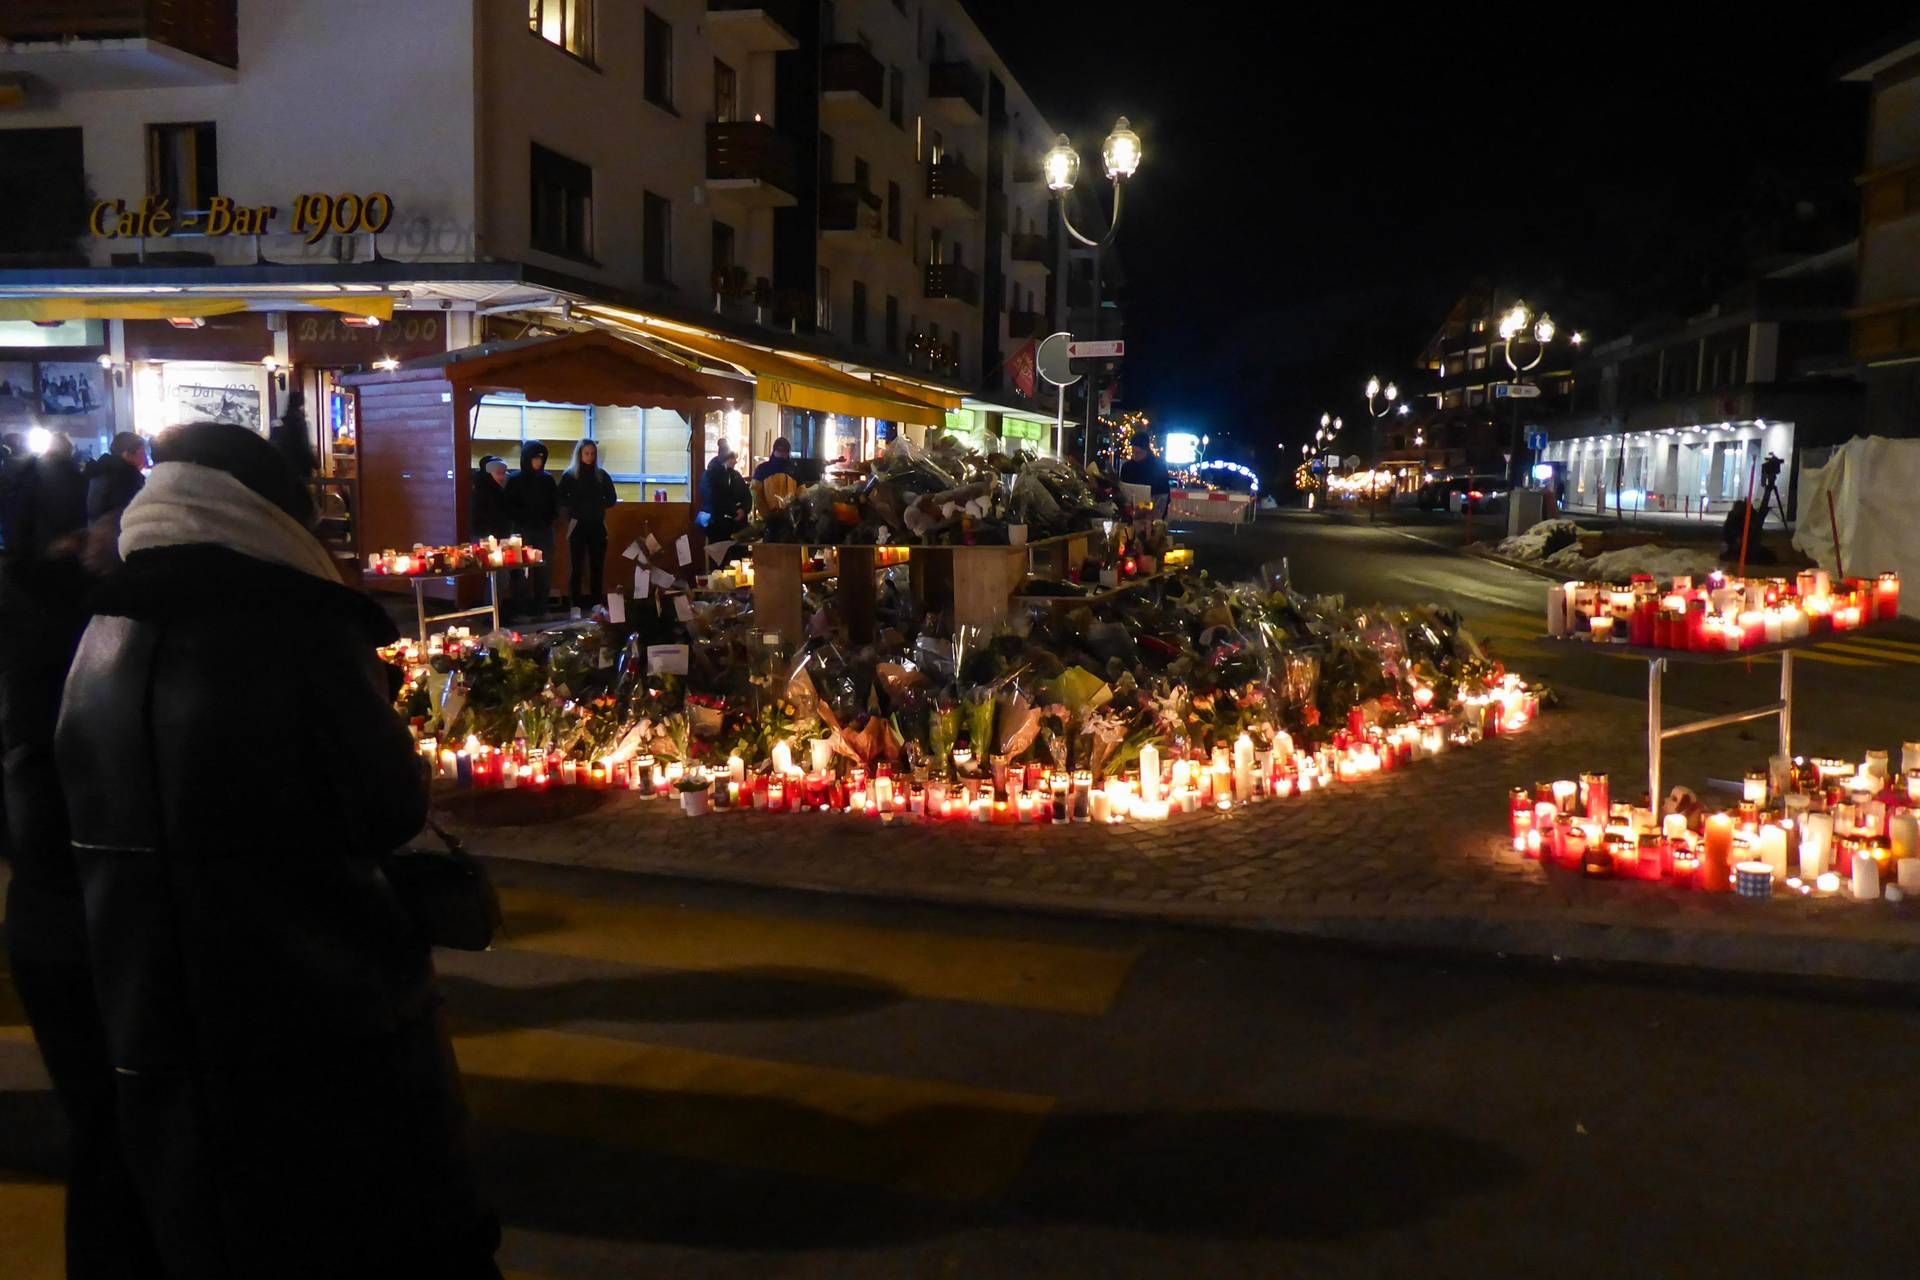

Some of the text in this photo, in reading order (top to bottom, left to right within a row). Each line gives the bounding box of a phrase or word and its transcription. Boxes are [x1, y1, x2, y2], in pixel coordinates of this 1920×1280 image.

[88, 197, 172, 238] Café
[206, 195, 275, 237] Bar
[291, 192, 391, 244] 1900
